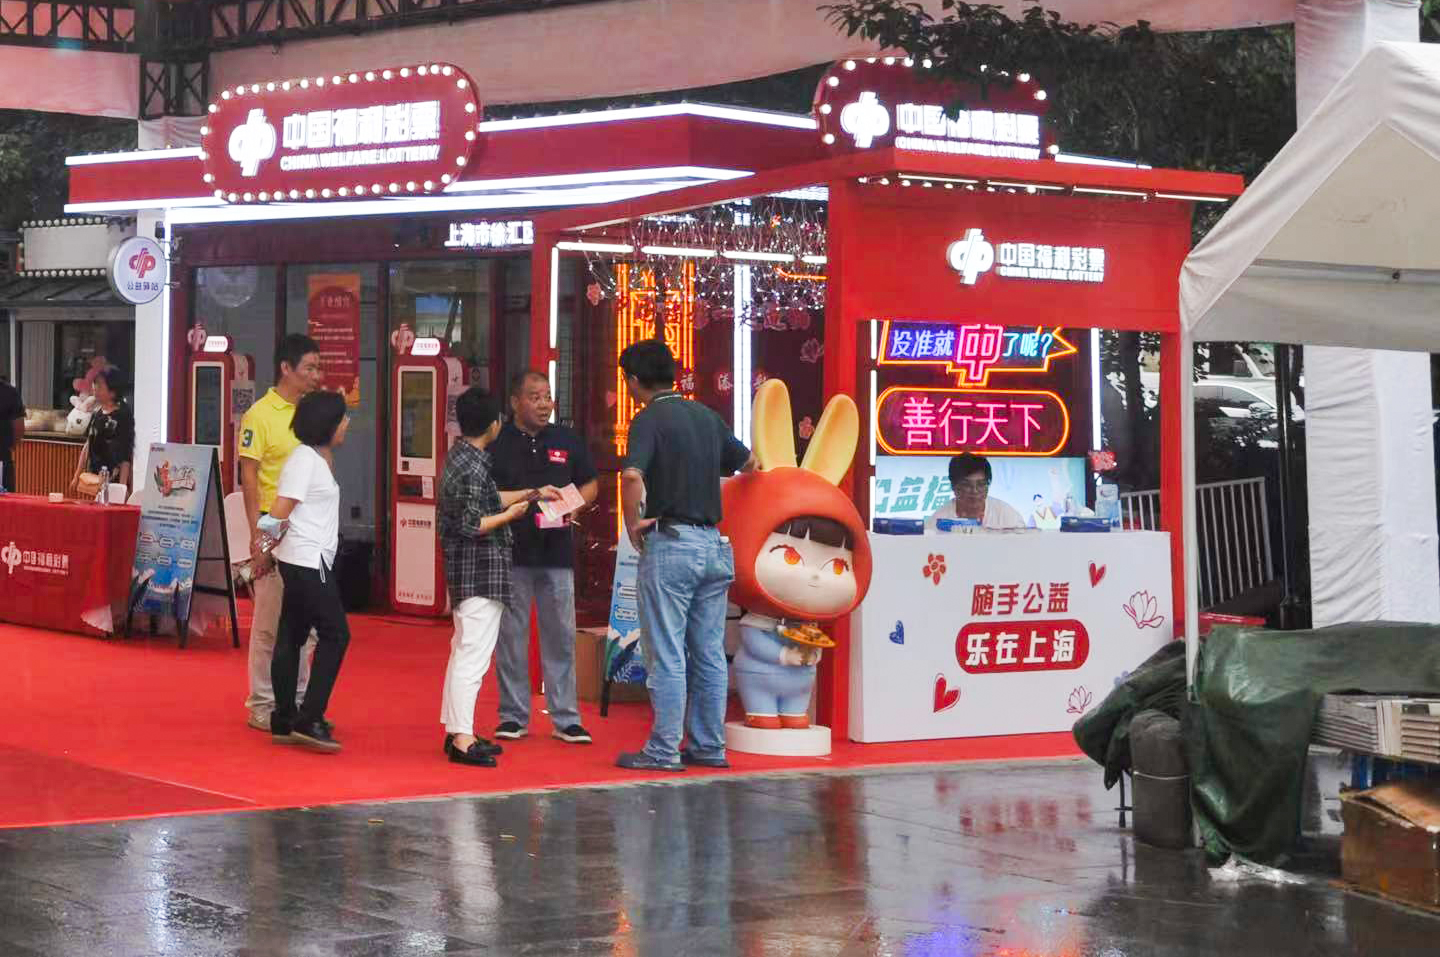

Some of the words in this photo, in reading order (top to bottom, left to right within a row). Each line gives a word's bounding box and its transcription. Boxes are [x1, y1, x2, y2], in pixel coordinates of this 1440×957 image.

[1000, 243, 1105, 272] 中国福利彩票
[902, 397, 1044, 447] 善行天下
[970, 581, 1071, 617] 随手公益
[965, 628, 1076, 666] 乐在上海
